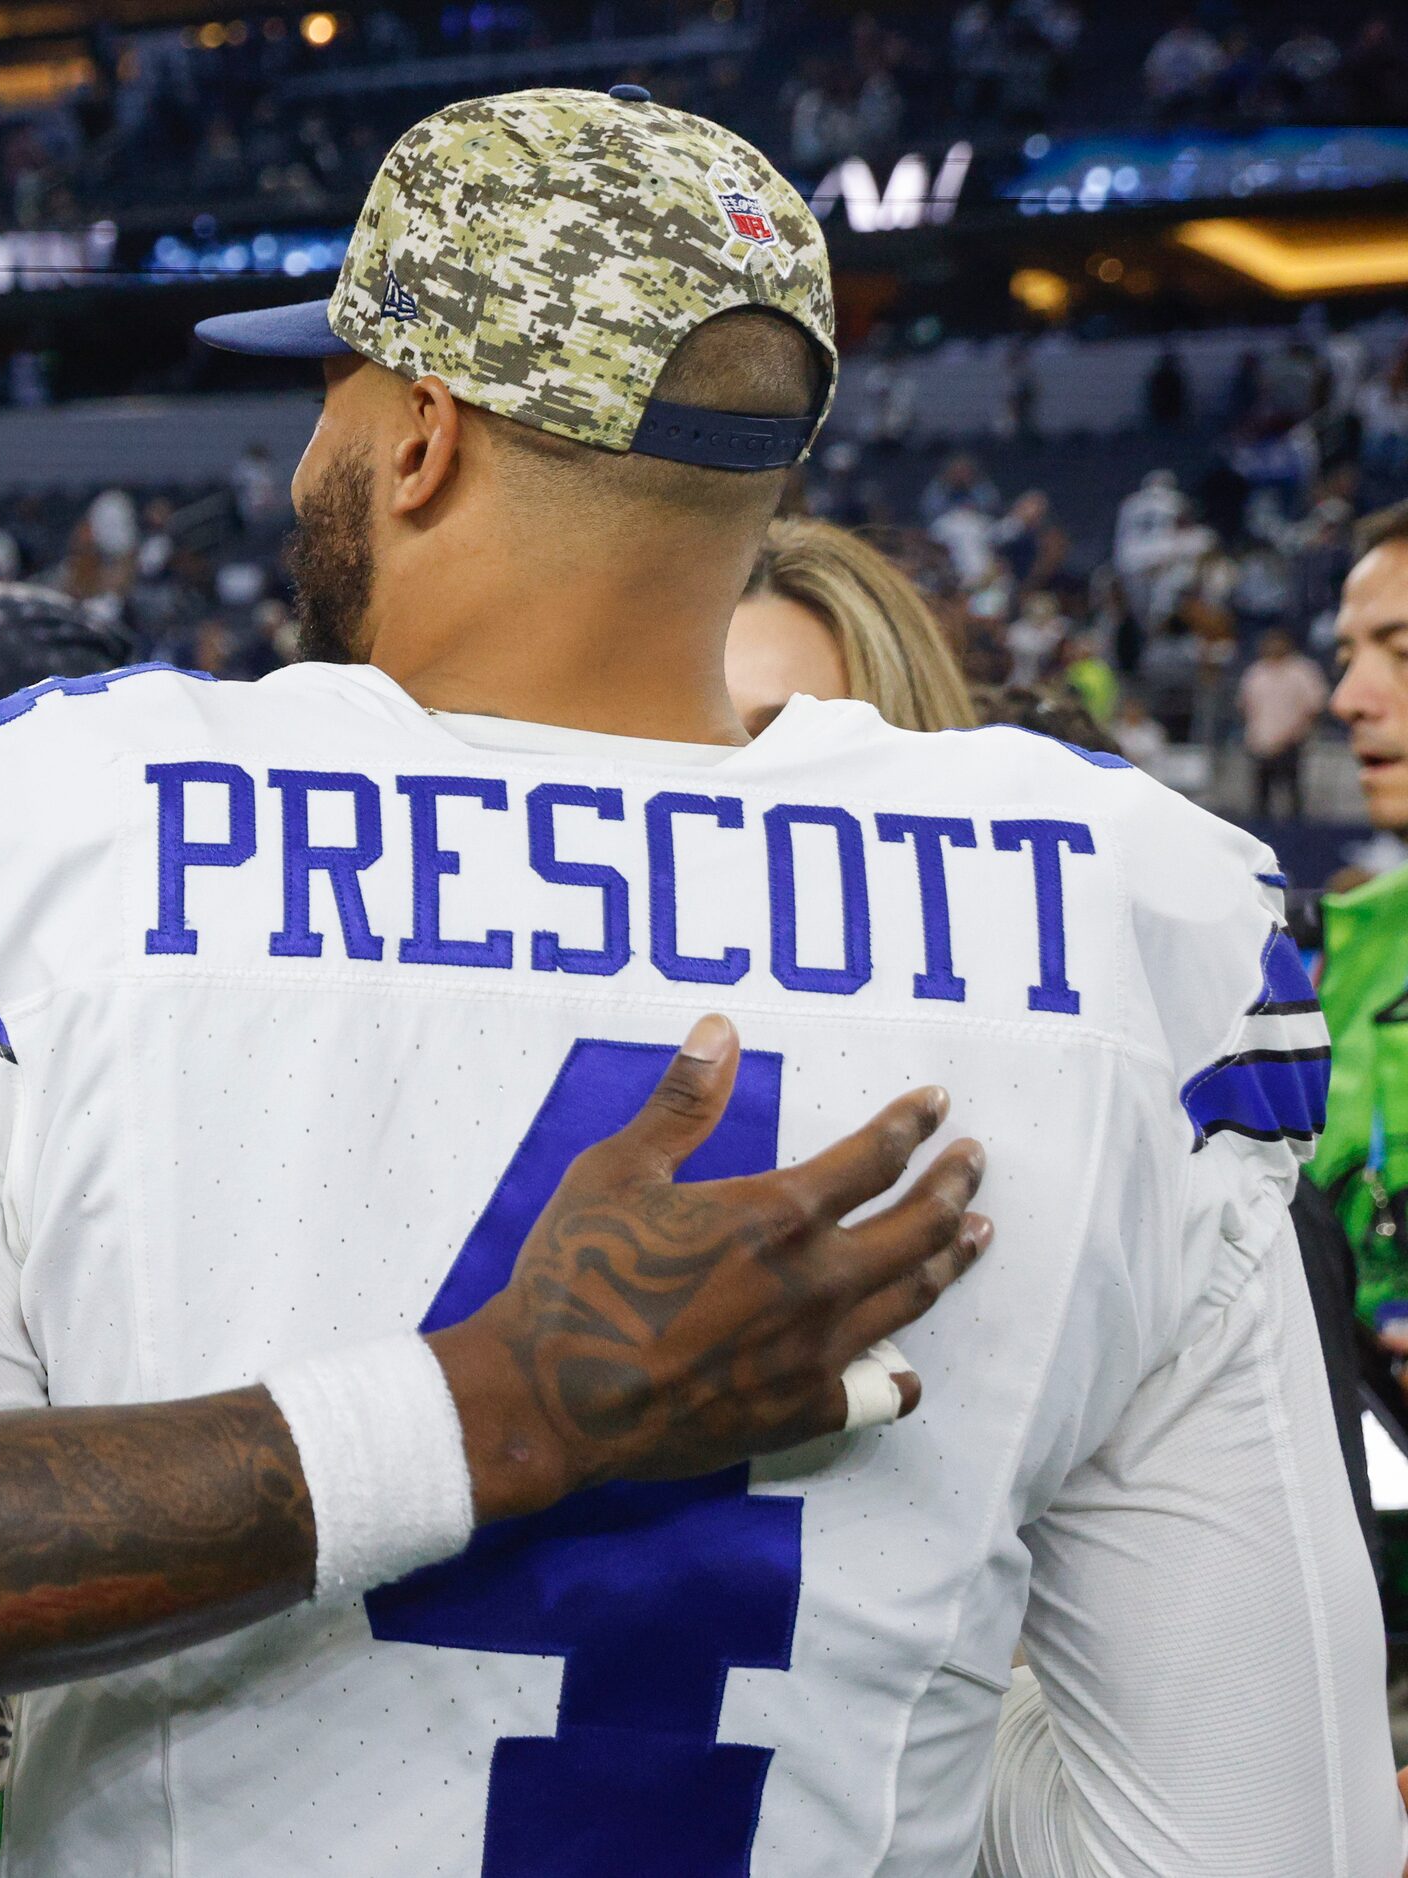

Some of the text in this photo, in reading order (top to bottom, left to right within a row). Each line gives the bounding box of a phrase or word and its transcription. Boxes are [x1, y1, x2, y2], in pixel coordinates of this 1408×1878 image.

[729, 211, 774, 240] NFL
[144, 760, 1095, 1015] PRESCOTT
[363, 1039, 804, 1878] 4
